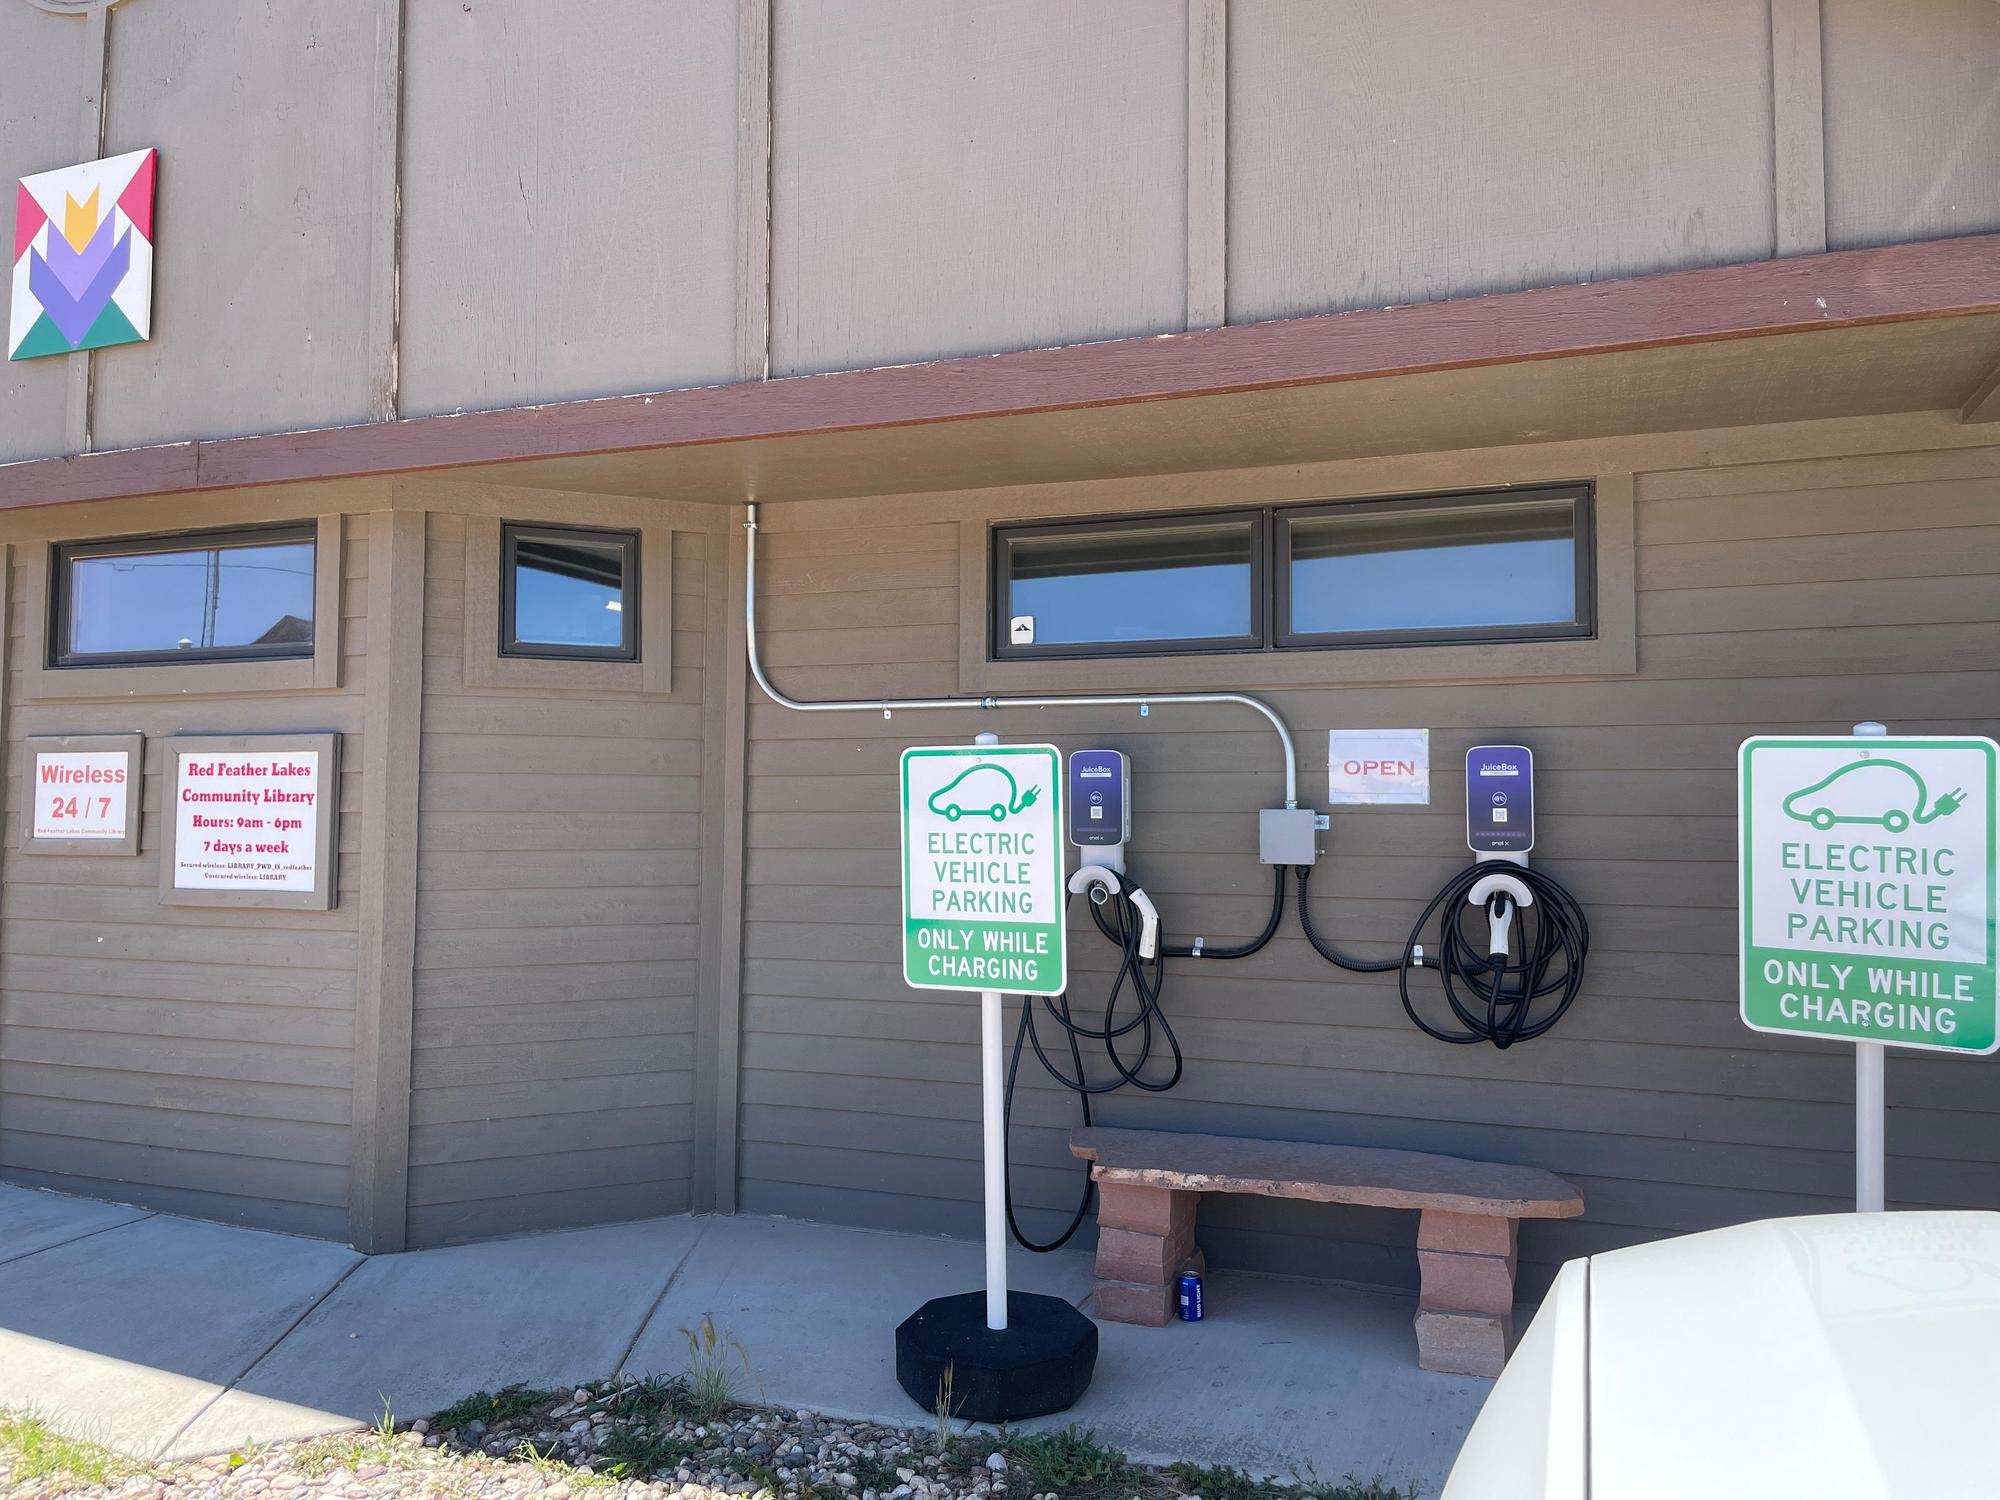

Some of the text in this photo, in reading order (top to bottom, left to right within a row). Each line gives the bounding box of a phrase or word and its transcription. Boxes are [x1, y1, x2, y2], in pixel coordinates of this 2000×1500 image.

[42, 765, 125, 784] Wireless
[188, 763, 311, 776] Red Feather Lakes
[1344, 760, 1414, 776] OPEN
[52, 796, 78, 818] 24
[98, 797, 111, 818] 7
[182, 789, 315, 805] Community Library
[193, 815, 234, 827] Hours:
[237, 817, 263, 828] 9am
[274, 818, 302, 831] 6pm
[204, 840, 288, 854] 7 days a week
[928, 832, 1035, 855] ELECTRIC
[1782, 842, 1955, 876] ELECTRIC
[934, 861, 1030, 884] VEHICLE
[932, 890, 1033, 914] PARKING
[1790, 878, 1947, 913] VEHICLE
[918, 928, 1048, 954] ONLY WHILE
[1788, 913, 1950, 950] PARKING
[928, 955, 1038, 981] CHARGING
[1764, 959, 1974, 1001] ONLY WHILE
[1780, 993, 1956, 1034] CHARGING
